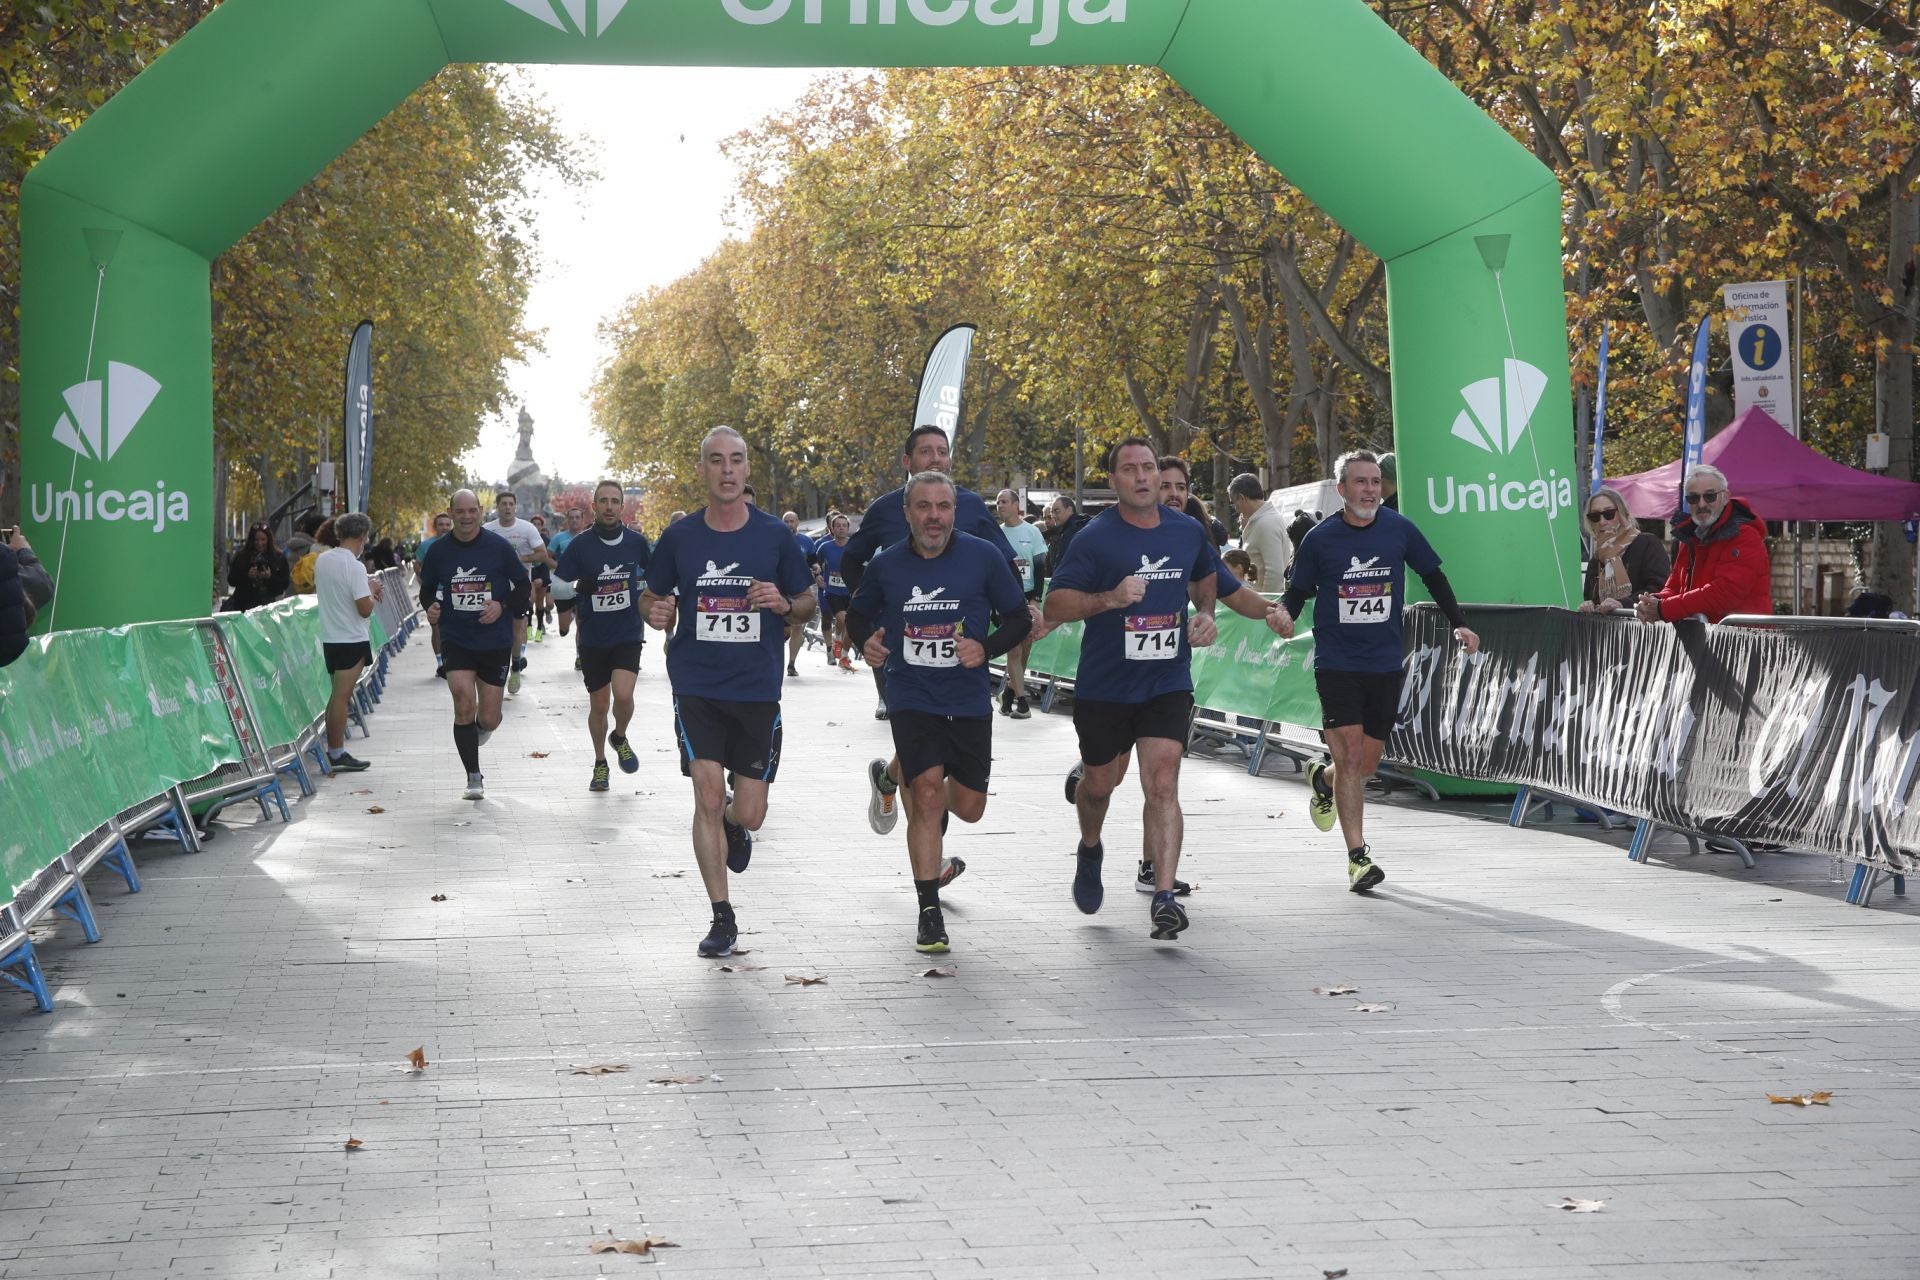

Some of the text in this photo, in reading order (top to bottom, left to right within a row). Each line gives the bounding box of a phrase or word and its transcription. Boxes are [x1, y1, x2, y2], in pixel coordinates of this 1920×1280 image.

[1732, 291, 1770, 300] Oficina de
[1427, 468, 1572, 520] Unicaja
[31, 480, 189, 533] Unicaja
[1343, 570, 1390, 579] MICHELIN
[696, 579, 752, 587] MICHELIN
[457, 593, 485, 606] 725
[597, 593, 625, 607] 726
[903, 603, 959, 612] MICHELIN
[1346, 598, 1385, 616] 744
[706, 614, 750, 633] 713
[1134, 631, 1176, 651] 714
[911, 641, 955, 659] 715
